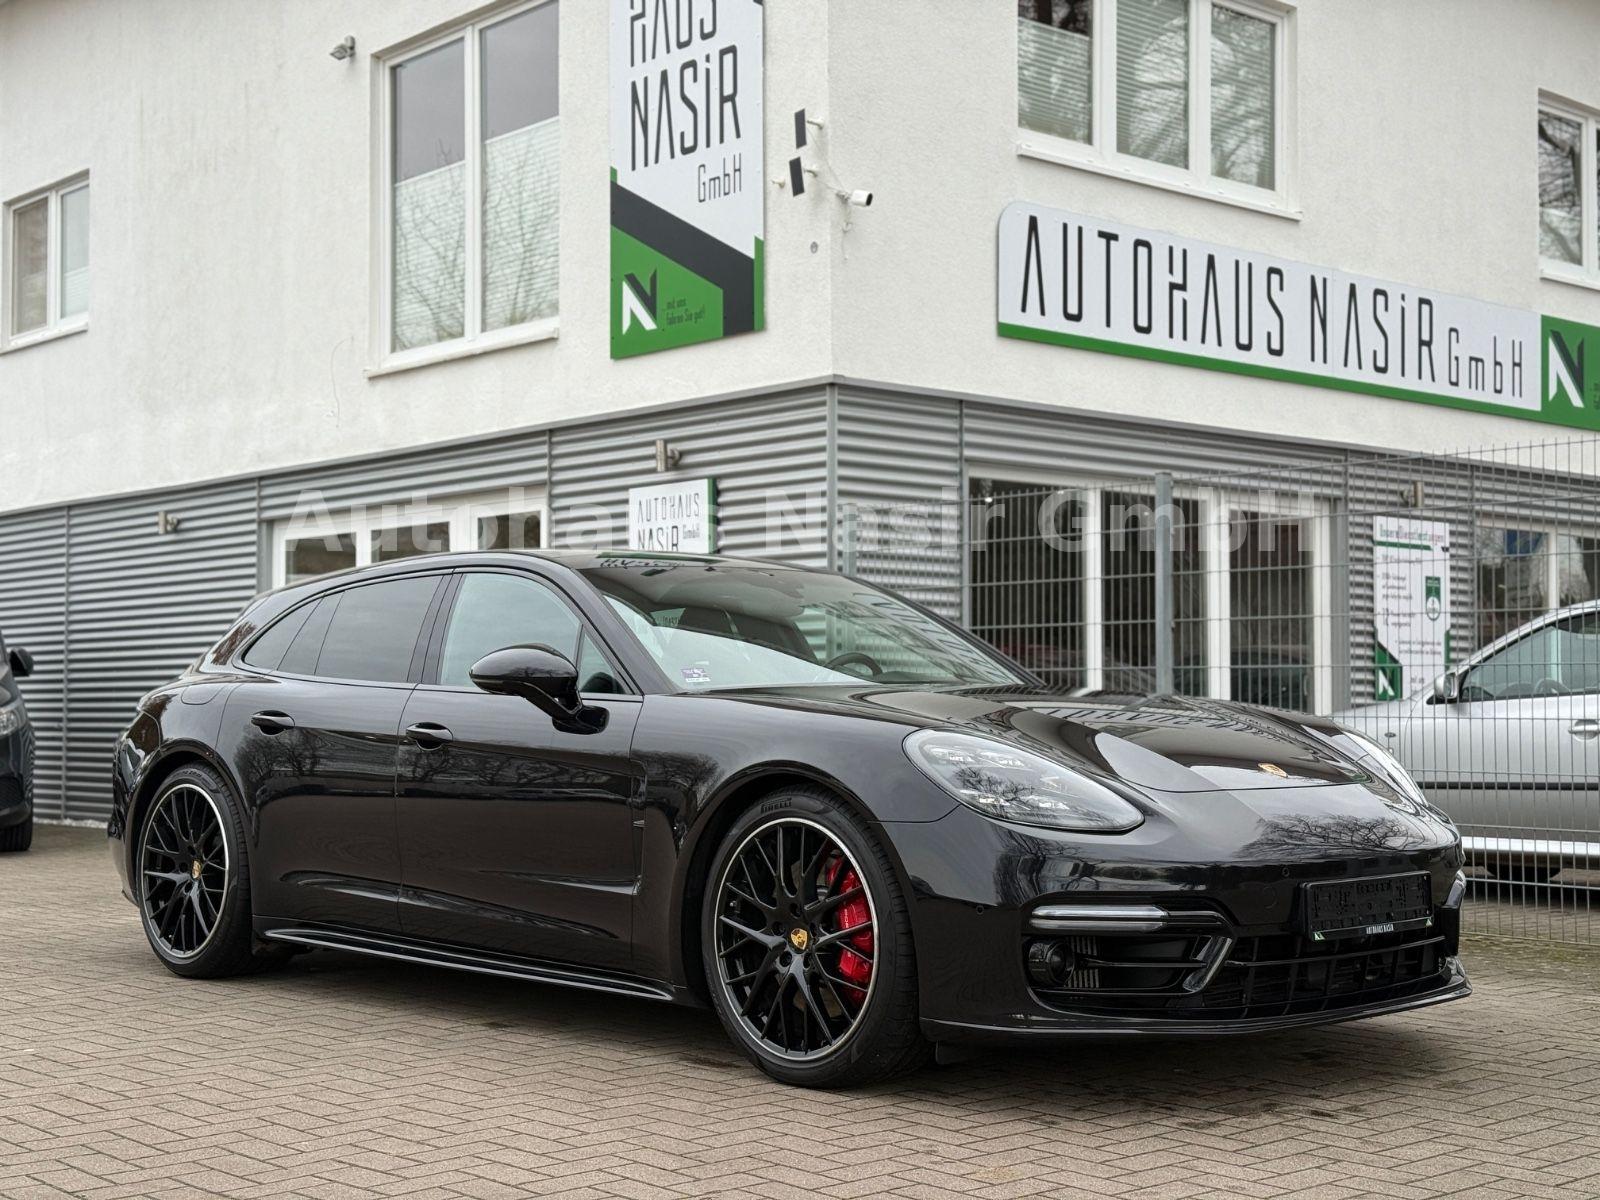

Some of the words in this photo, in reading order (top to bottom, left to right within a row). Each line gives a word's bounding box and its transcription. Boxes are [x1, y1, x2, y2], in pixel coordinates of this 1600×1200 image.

[698, 153, 742, 203] GmbH
[1020, 215, 1285, 356] AUTOHAUS
[1448, 327, 1523, 398] GmbH
[637, 493, 700, 524] AUTOHAUS
